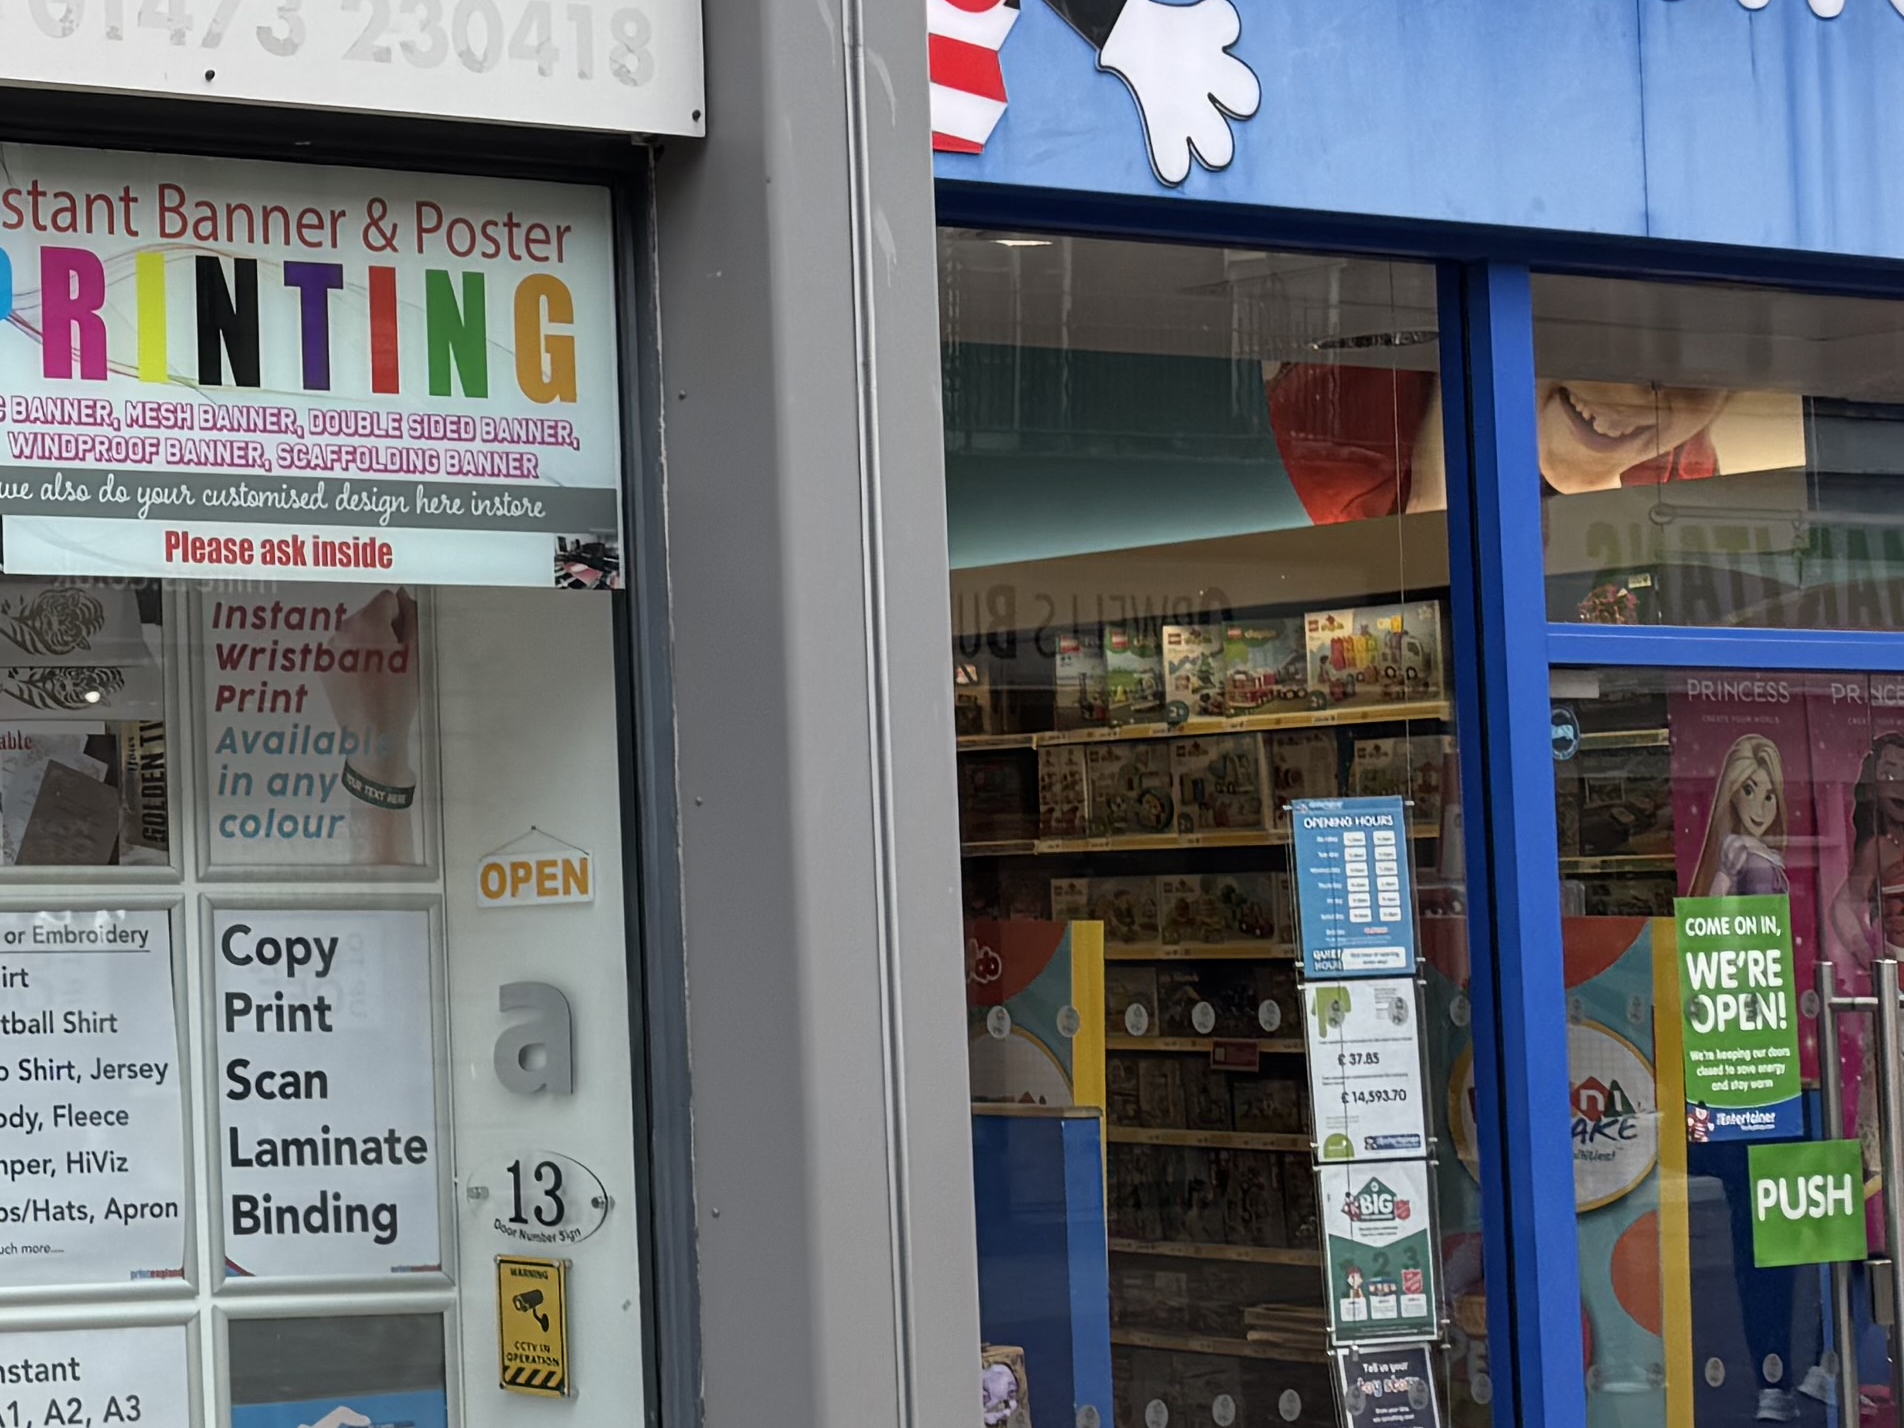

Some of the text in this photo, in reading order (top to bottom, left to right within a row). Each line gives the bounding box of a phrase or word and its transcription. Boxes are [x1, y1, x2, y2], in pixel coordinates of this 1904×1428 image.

[158, 182, 346, 249] Banner
[362, 197, 399, 253] &
[416, 200, 572, 263] Poster
[11, 395, 121, 431] BANNER,
[125, 400, 192, 431] MESH
[198, 403, 305, 439] BANNER,
[308, 408, 403, 439] DOUBLE
[407, 413, 475, 442] SIDED
[480, 417, 580, 451] BANNER,
[8, 431, 539, 479] WINDPROOF BANNER, SCAFFOLDING BANNER
[41, 472, 91, 502] also
[99, 473, 130, 503] do
[137, 485, 195, 520] your
[203, 480, 328, 509] customised
[336, 482, 409, 526] design
[416, 485, 464, 515] here
[471, 491, 546, 518] instore
[165, 530, 392, 571] Please ask inside
[212, 601, 347, 631] Instant
[216, 640, 410, 672] Wristband
[215, 681, 308, 713] Print
[1687, 679, 1790, 703] PRINCESS
[215, 724, 392, 756] Available
[218, 764, 339, 803] in any
[218, 808, 345, 839] colour
[480, 857, 589, 900] OPEN
[3, 929, 26, 945] or
[32, 924, 149, 949] Embroidery
[1685, 915, 1782, 937] COME ON IN,
[221, 923, 339, 978] Copy
[1685, 948, 1784, 992] WE'RE
[63, 1010, 119, 1035] Shirt
[225, 990, 334, 1033] Print
[1688, 990, 1788, 1034] OPEN!
[1716, 1045, 1791, 1063] keeping doors
[18, 1058, 82, 1084] Shirt,
[90, 1057, 168, 1085] Jersey
[226, 1057, 328, 1101] Scan
[1696, 1064, 1757, 1077] closed save
[1711, 1078, 1773, 1094] and stay warm
[53, 1104, 129, 1127] Fleece
[67, 1150, 129, 1173] HiViz
[229, 1124, 428, 1168] Laminate
[506, 1159, 565, 1227] 13
[1359, 1193, 1394, 1216] BIG
[1757, 1172, 1854, 1222] PUSH
[104, 1197, 179, 1225] Apron
[231, 1190, 398, 1245] Binding
[494, 1217, 582, 1244] Door Number Sign
[510, 1267, 549, 1281] WARNING
[506, 1352, 560, 1368] OPERATION
[103, 1394, 141, 1423] A3
